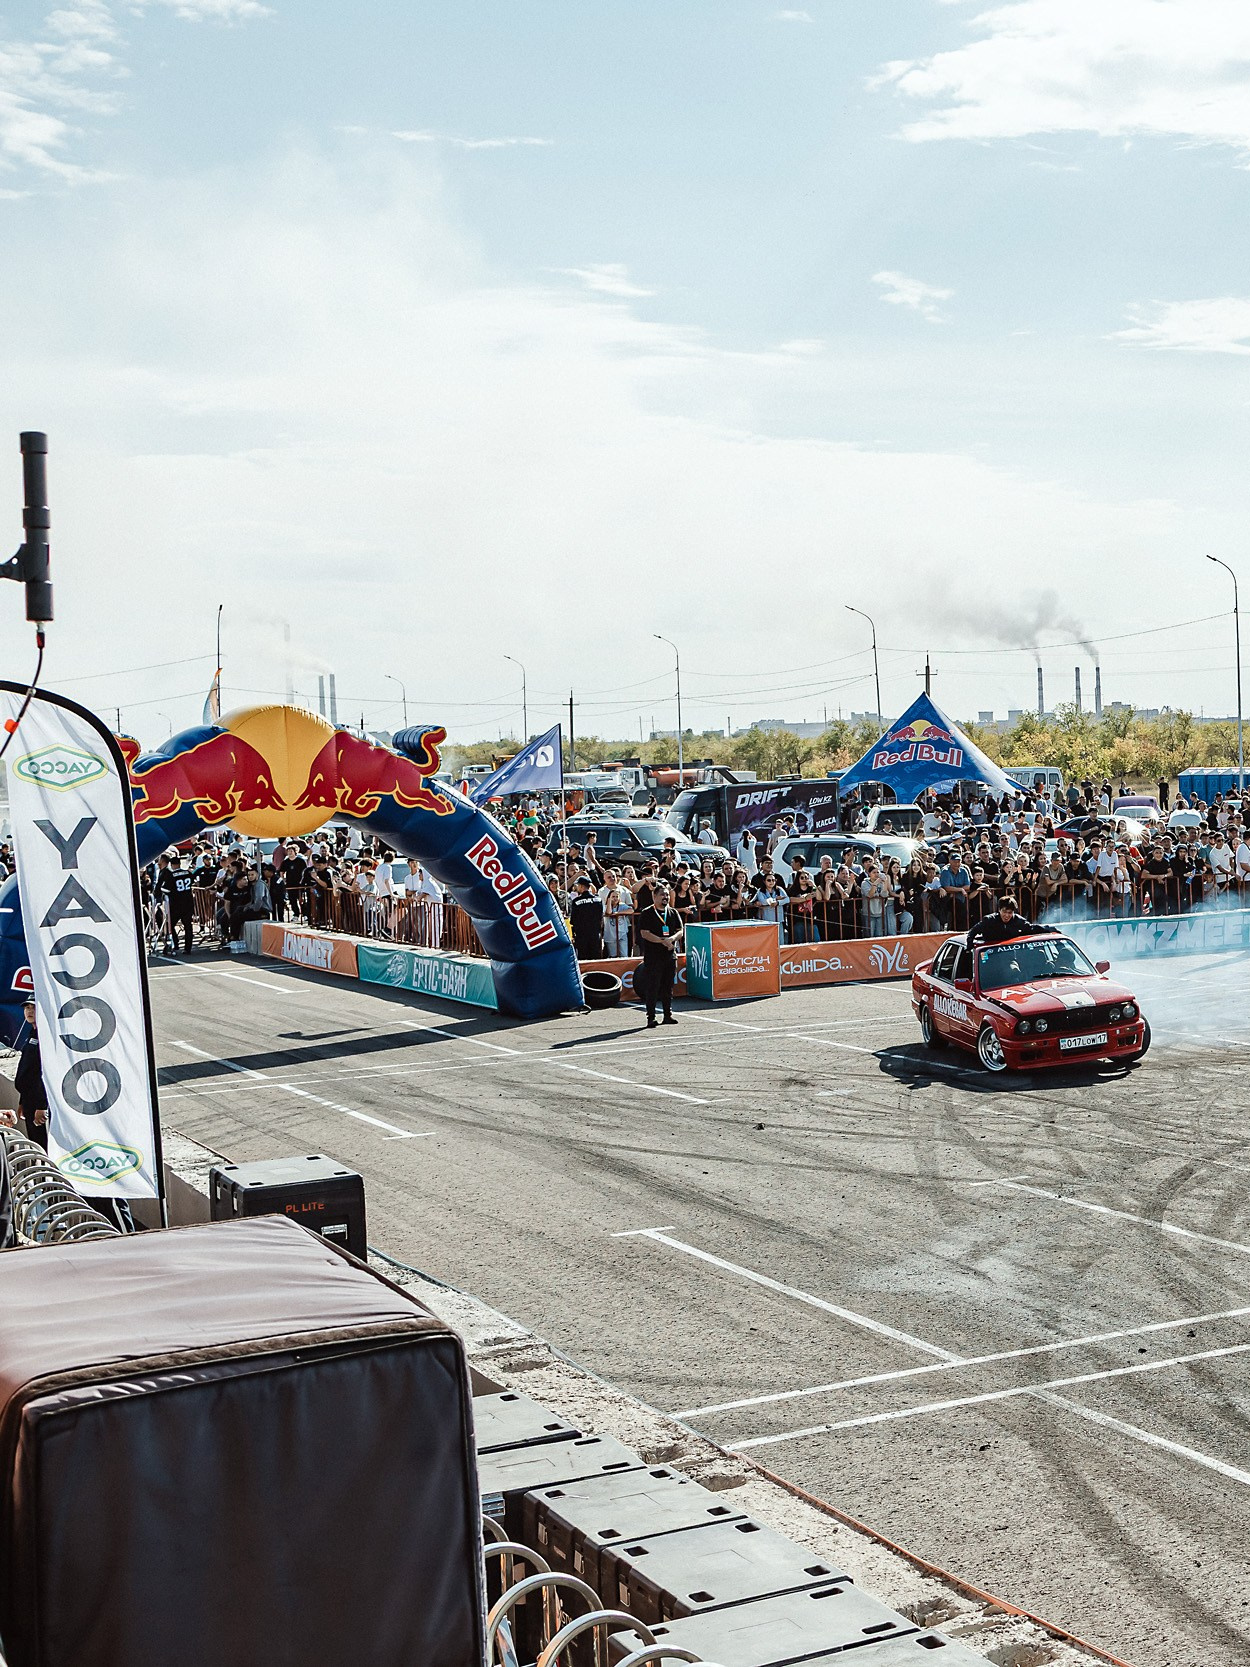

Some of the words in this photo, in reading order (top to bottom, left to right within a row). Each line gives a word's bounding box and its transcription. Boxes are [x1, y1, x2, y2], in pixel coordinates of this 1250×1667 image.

[872, 743, 916, 770] Red
[916, 743, 963, 768] Bull
[735, 786, 793, 810] DRIFT
[175, 877, 192, 892] 92
[464, 832, 528, 899] Red
[503, 886, 559, 951] Bull
[285, 1204, 300, 1213] PL
